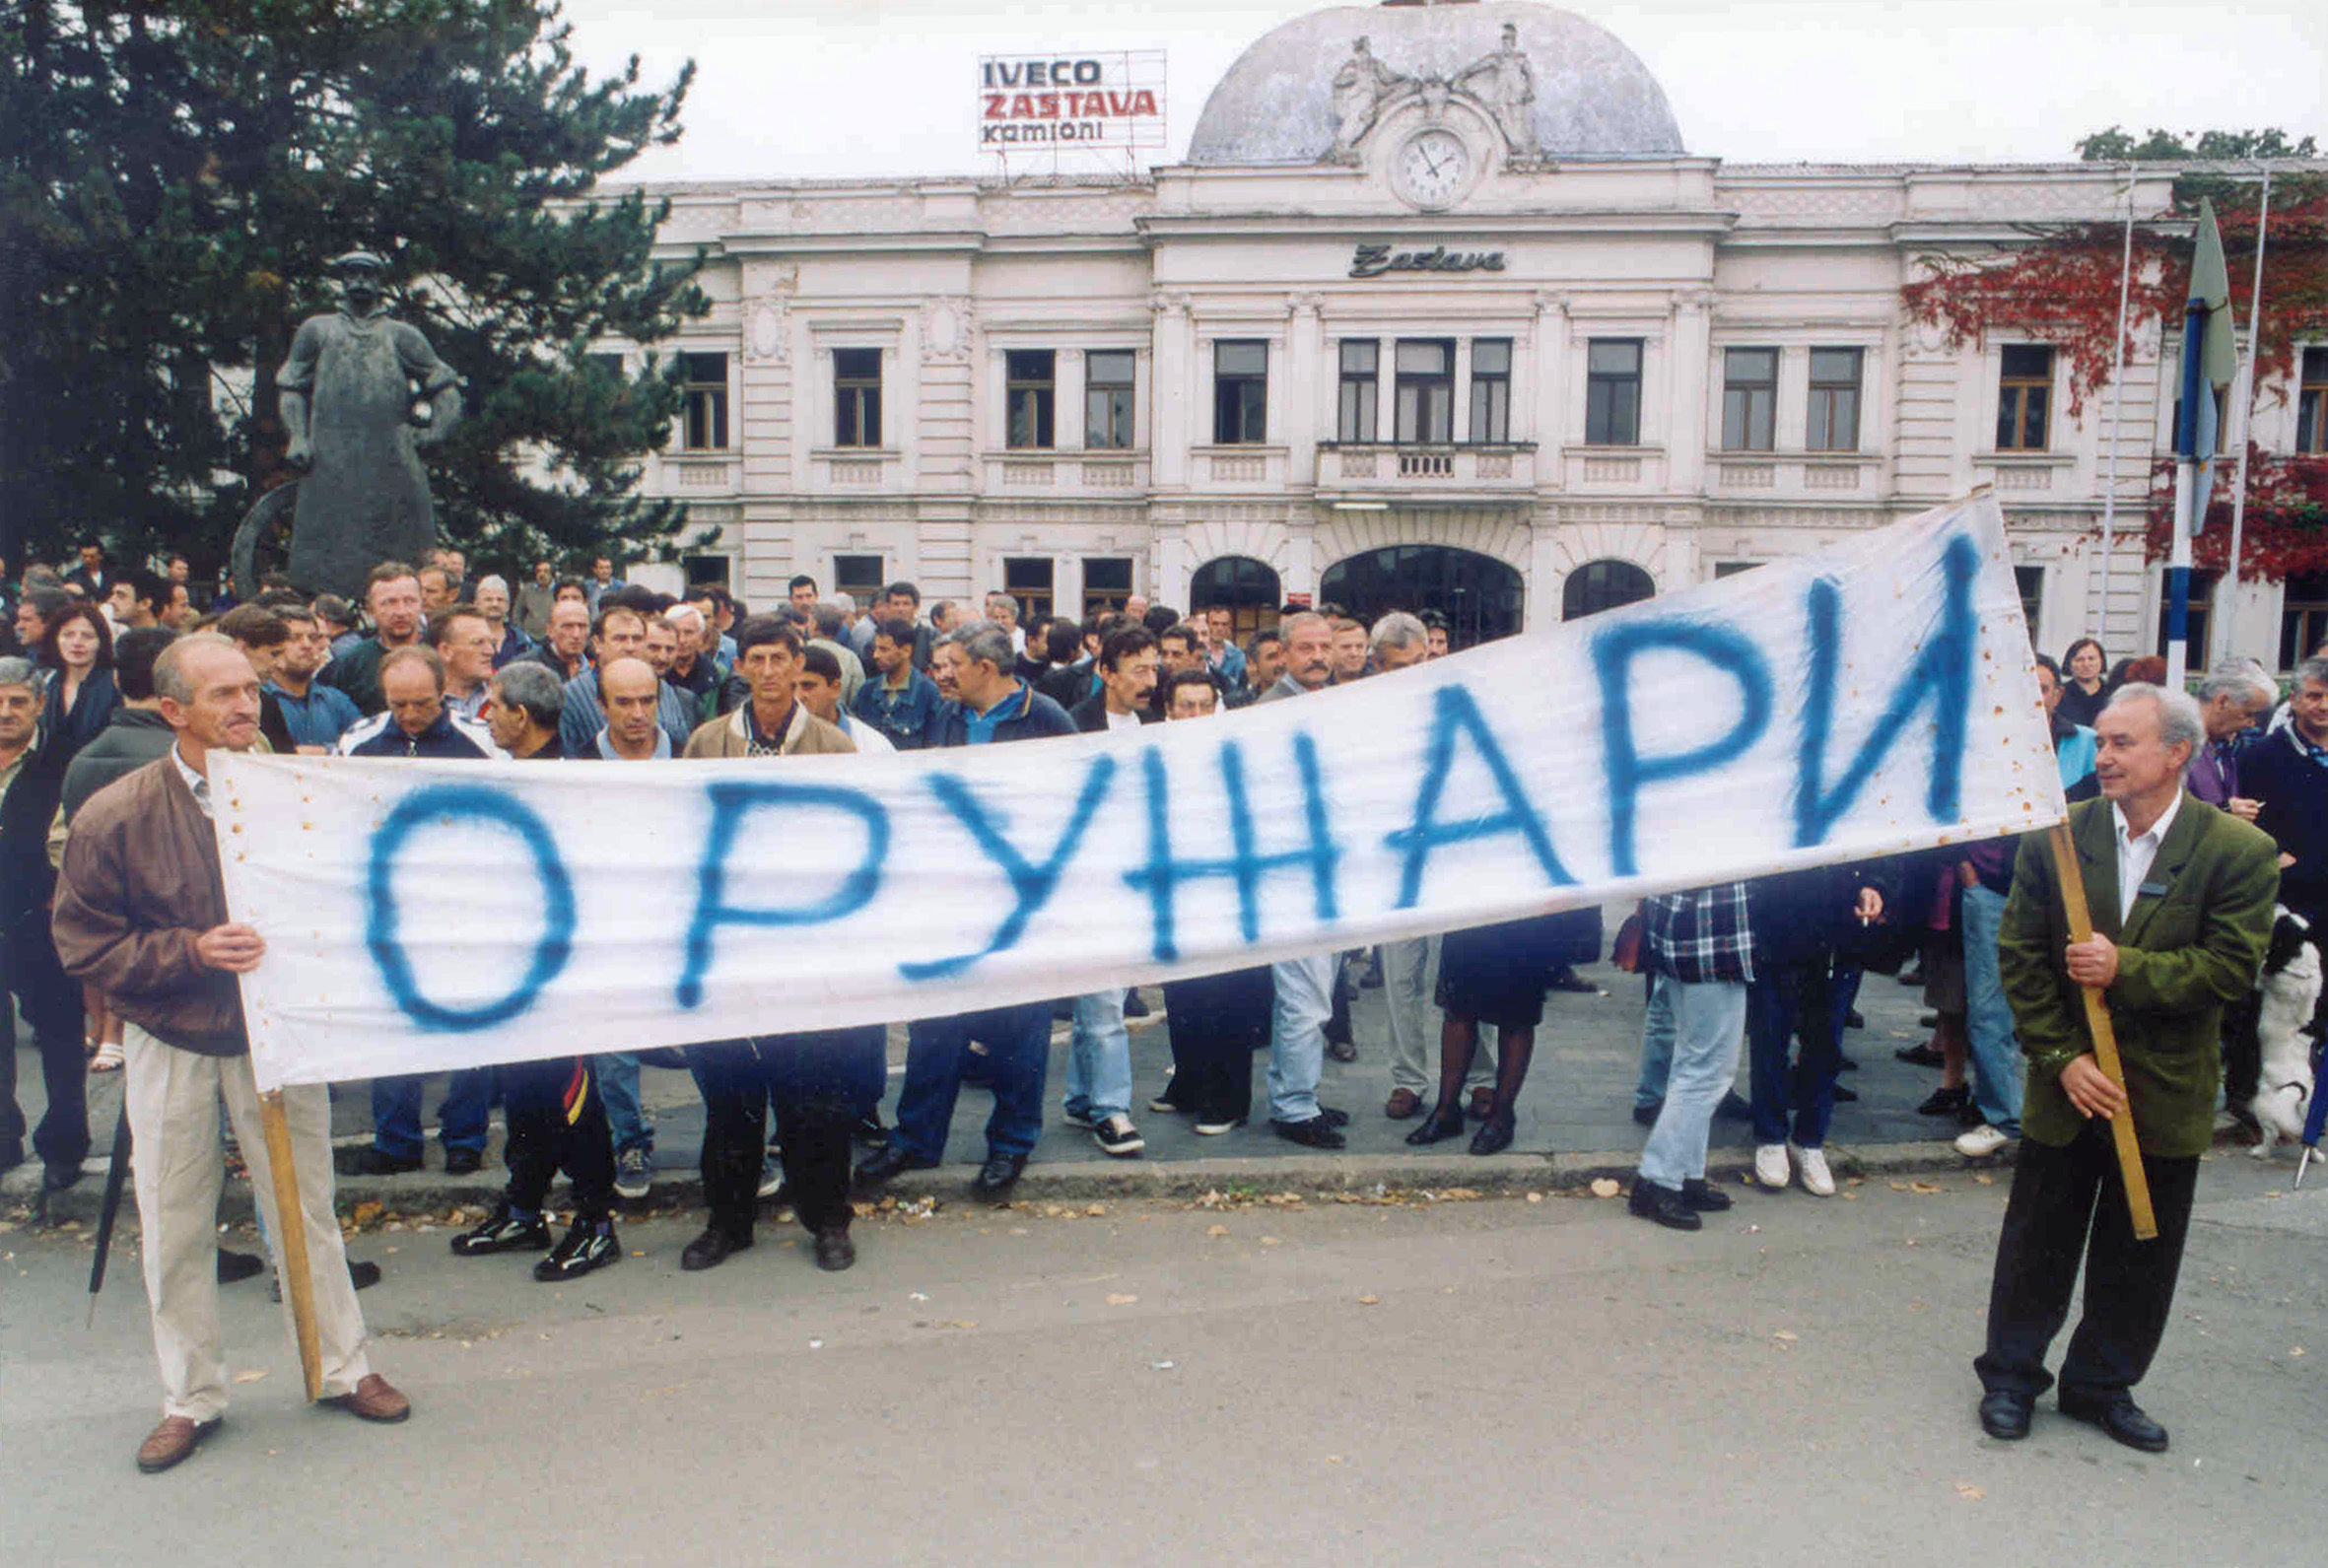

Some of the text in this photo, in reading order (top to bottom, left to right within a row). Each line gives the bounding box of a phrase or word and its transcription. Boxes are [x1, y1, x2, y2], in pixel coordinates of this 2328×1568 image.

[984, 59, 1102, 88] IVECO
[983, 90, 1158, 119] ZASTAVA
[983, 120, 1103, 143] kamioni
[365, 532, 1983, 1035] ОРУЖАРИ
